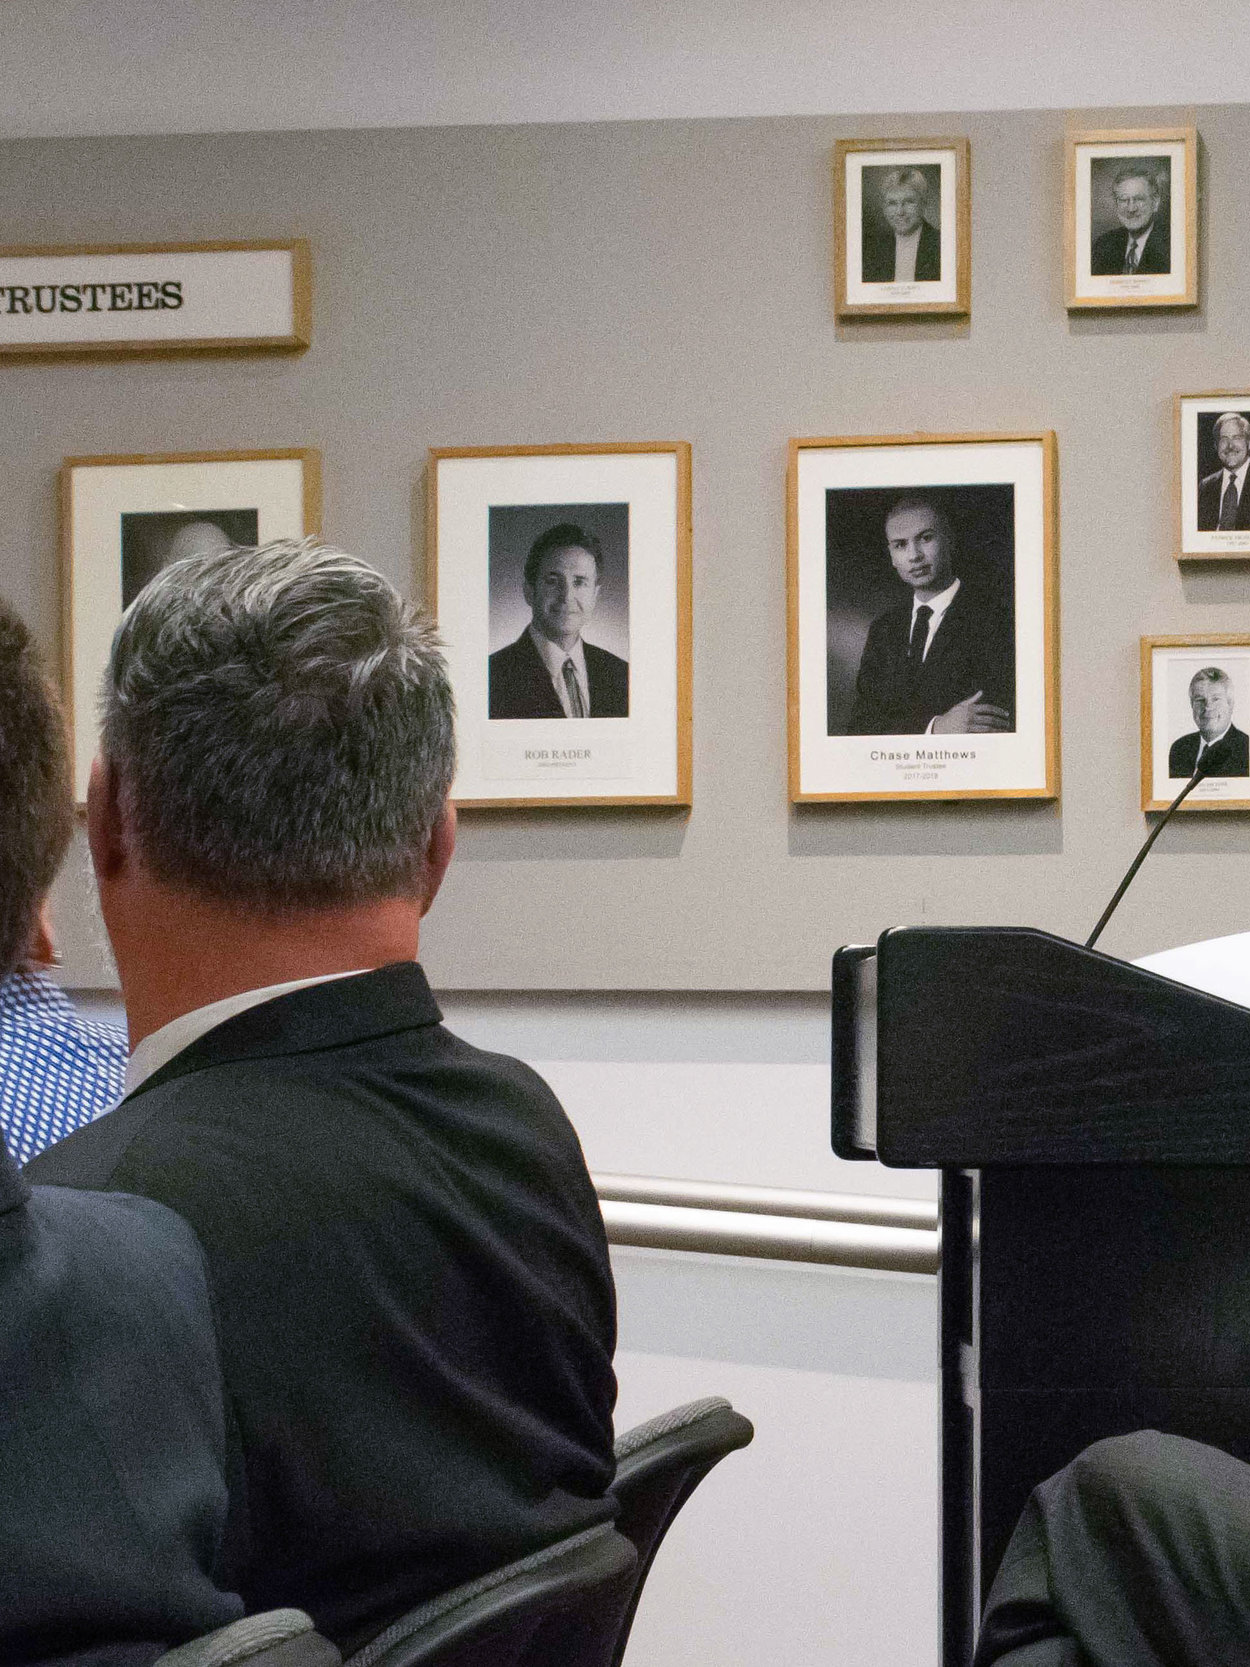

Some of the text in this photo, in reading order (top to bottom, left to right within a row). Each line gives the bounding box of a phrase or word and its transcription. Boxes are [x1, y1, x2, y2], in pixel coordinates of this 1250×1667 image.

[0, 281, 184, 314] RUSTEES
[525, 748, 592, 760] ROB RADER
[870, 749, 977, 761] Chase Matthews
